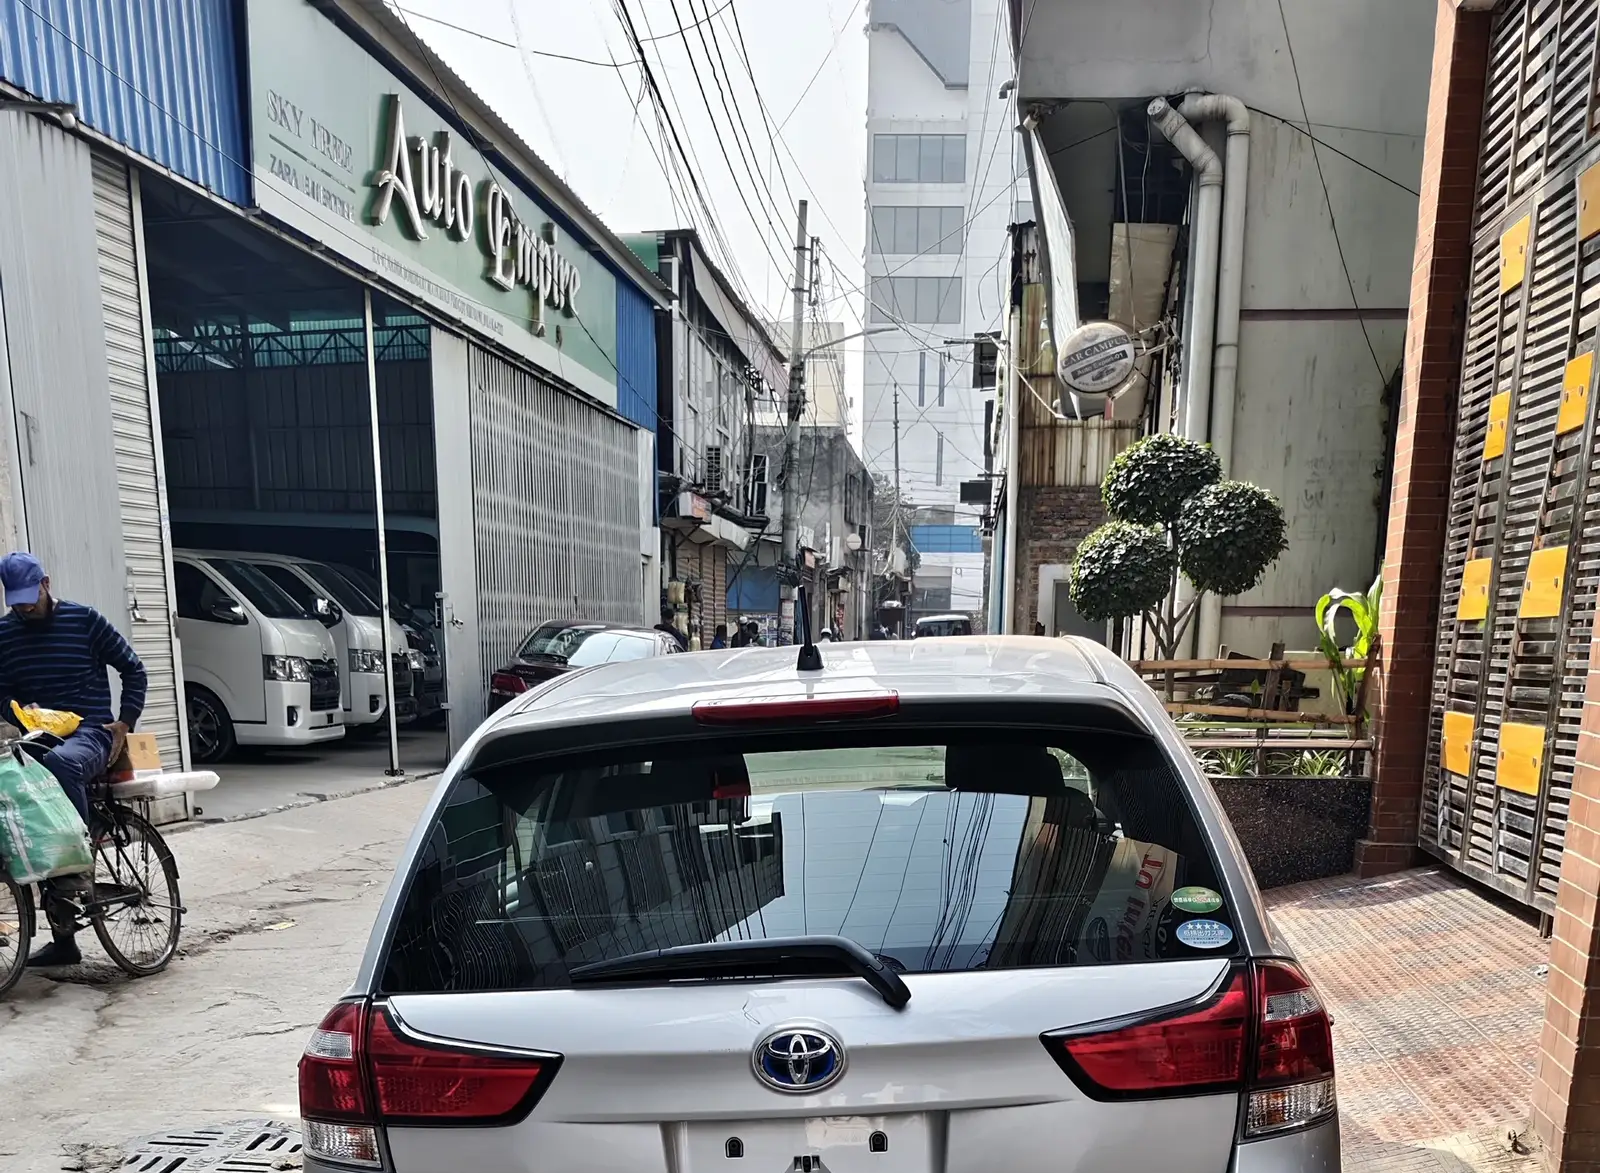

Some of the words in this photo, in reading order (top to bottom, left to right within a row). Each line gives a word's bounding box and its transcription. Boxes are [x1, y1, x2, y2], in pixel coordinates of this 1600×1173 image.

[267, 89, 303, 138] SKY
[308, 116, 354, 174] TREE
[268, 153, 300, 191] ZARA
[373, 93, 474, 242] Auto
[483, 181, 581, 337] Empire
[1062, 353, 1084, 368] CAR
[1084, 336, 1129, 357] CAMPUS
